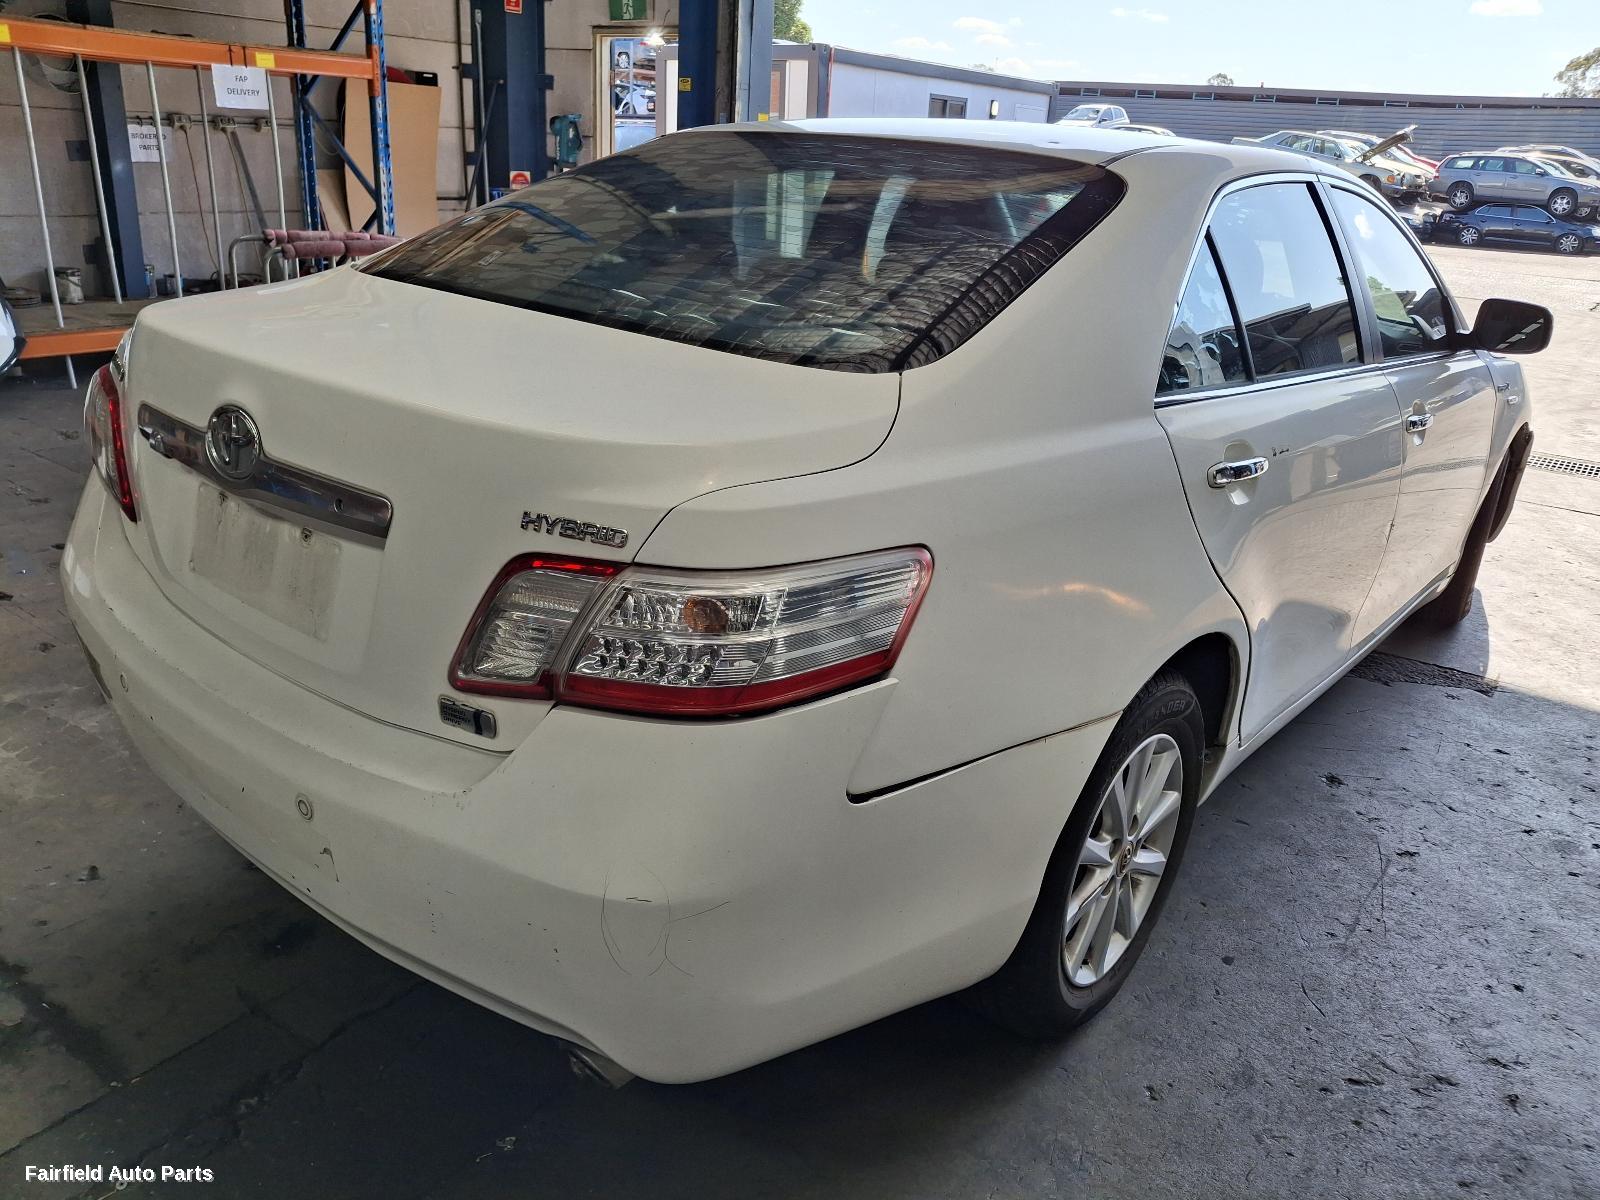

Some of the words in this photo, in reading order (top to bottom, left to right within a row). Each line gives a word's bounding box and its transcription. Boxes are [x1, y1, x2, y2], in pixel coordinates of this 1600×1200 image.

[226, 87, 260, 97] DELIVERY
[130, 132, 167, 140] BROKERD
[520, 511, 629, 549] HYBRID
[443, 715, 462, 726] DRIVE
